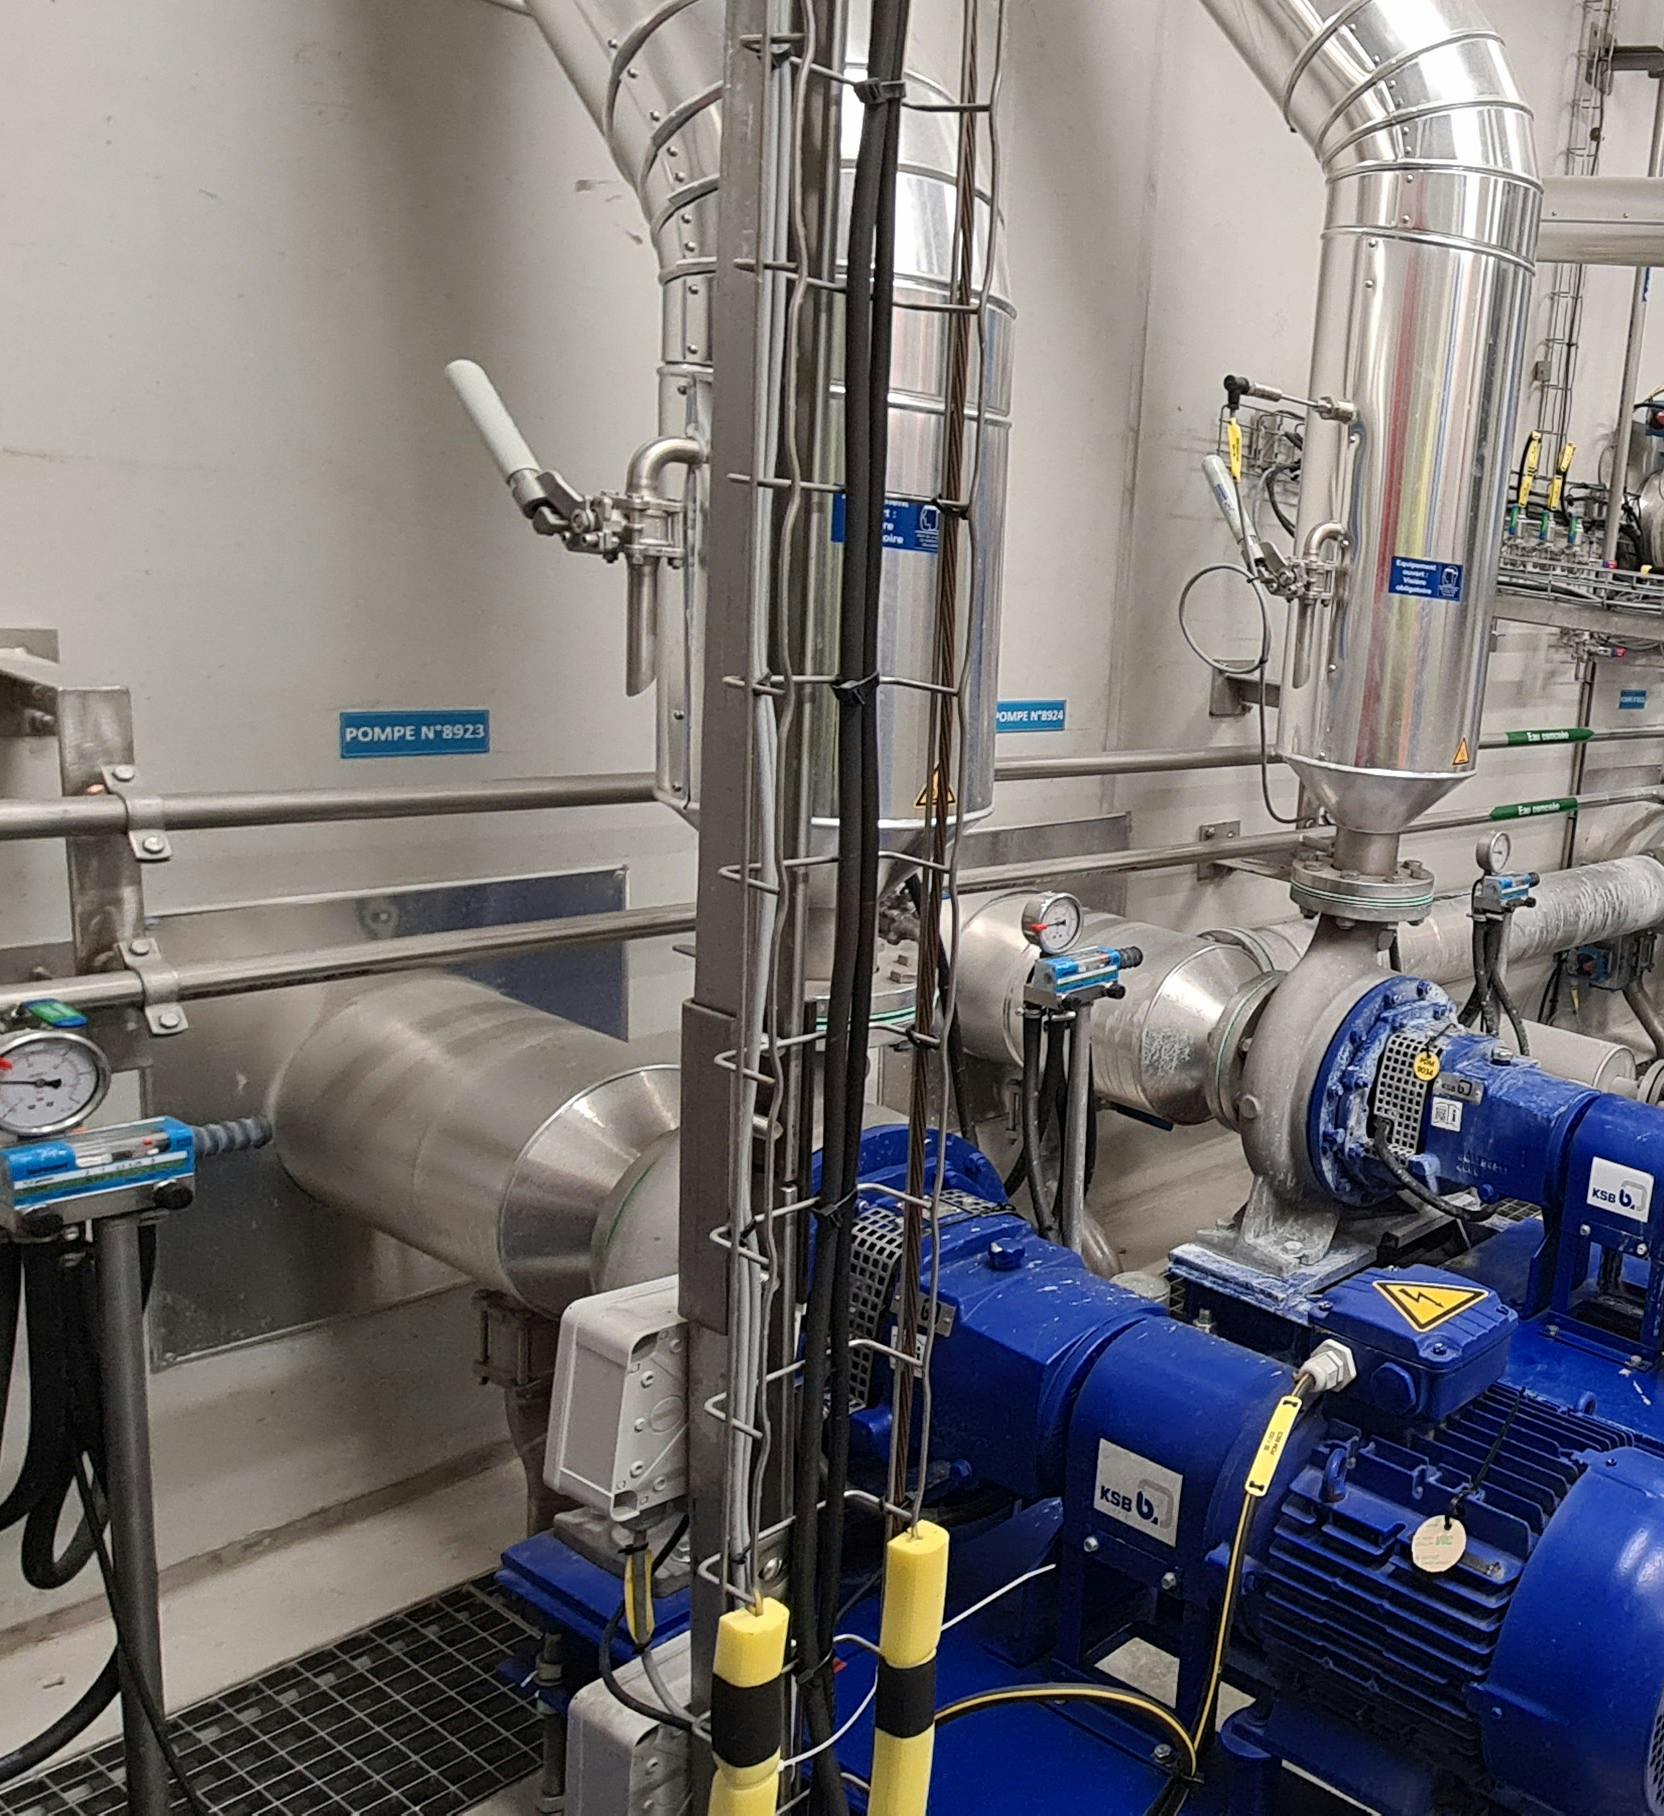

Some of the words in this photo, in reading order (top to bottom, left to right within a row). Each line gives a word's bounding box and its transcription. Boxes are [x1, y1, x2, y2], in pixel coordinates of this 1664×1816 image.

[1030, 709, 1063, 721] N°8924
[345, 725, 416, 742] POMPE
[421, 723, 485, 740] N°8923
[1592, 1187, 1616, 1203] KSB
[1100, 1485, 1132, 1512] KSB
